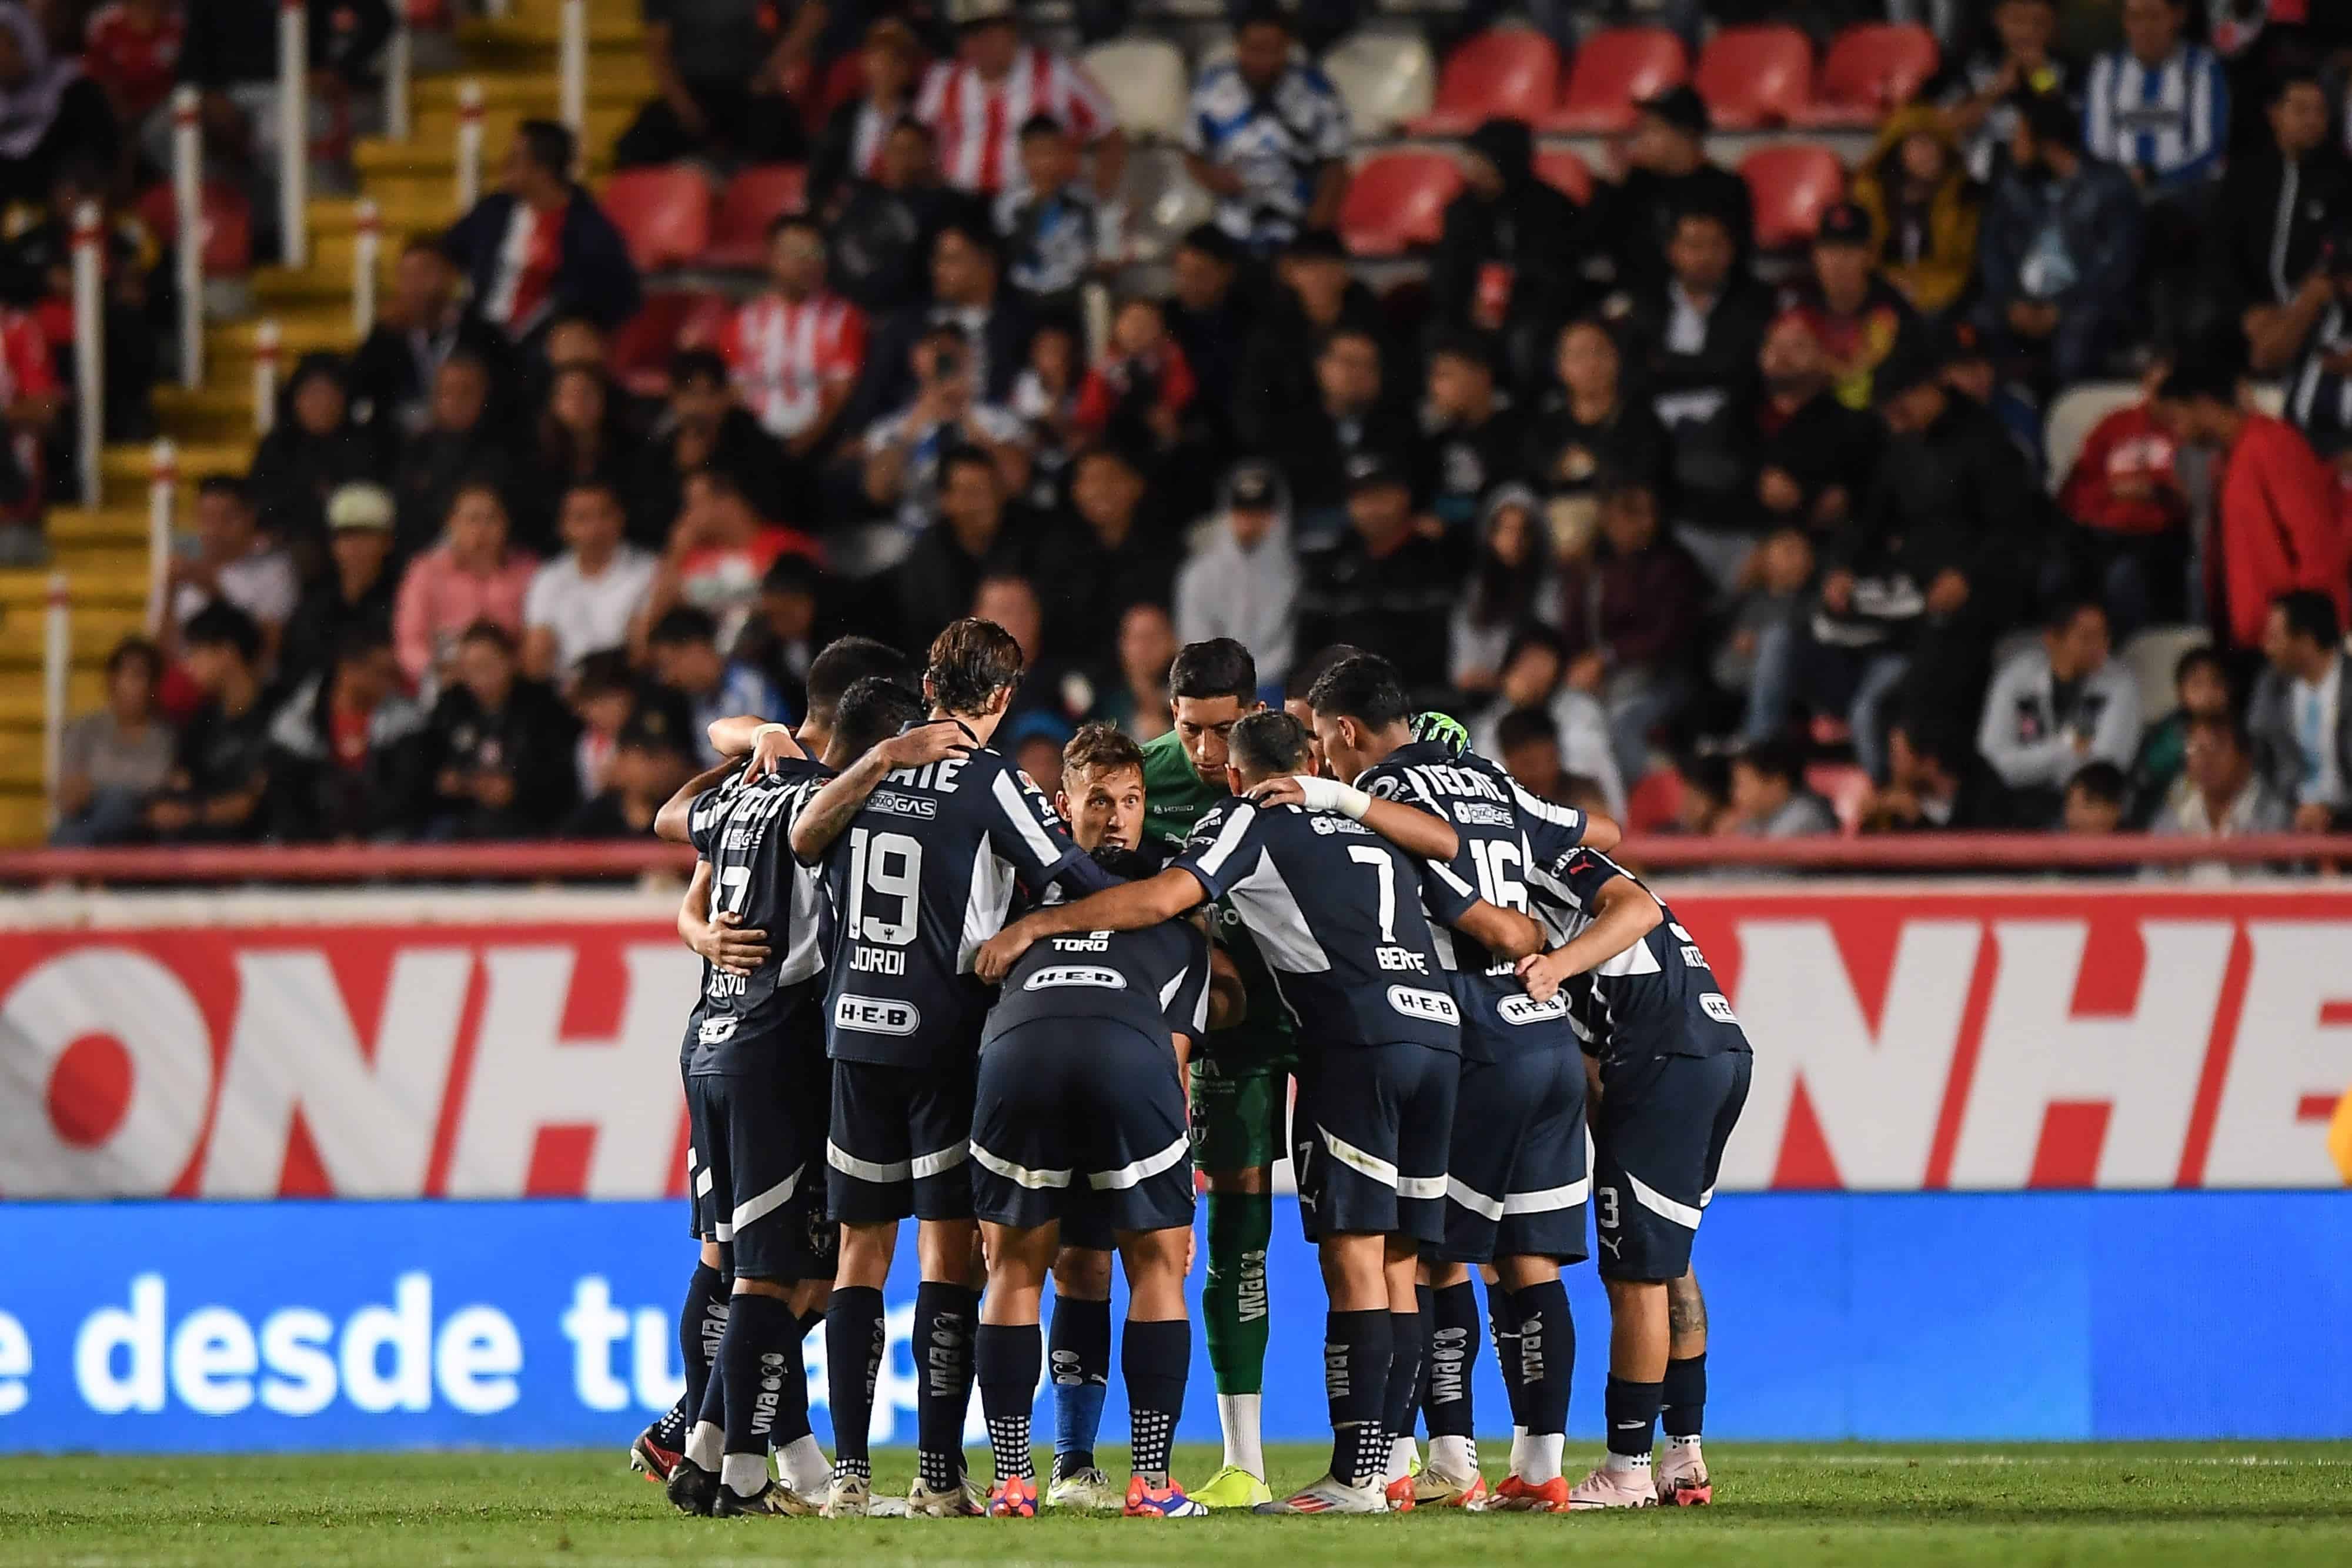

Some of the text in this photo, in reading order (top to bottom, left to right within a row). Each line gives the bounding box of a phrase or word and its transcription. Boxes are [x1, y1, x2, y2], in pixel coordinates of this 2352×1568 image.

[896, 798, 934, 815] GAS
[848, 827, 922, 945] 19
[1347, 845, 1396, 942] 7
[1469, 840, 1528, 914] 16
[850, 946, 906, 975] JORDI
[1052, 939, 1109, 951] TORO
[1299, 1141, 1313, 1185] 7
[1600, 1187, 1619, 1228] 3
[76, 1273, 522, 1413] desde
